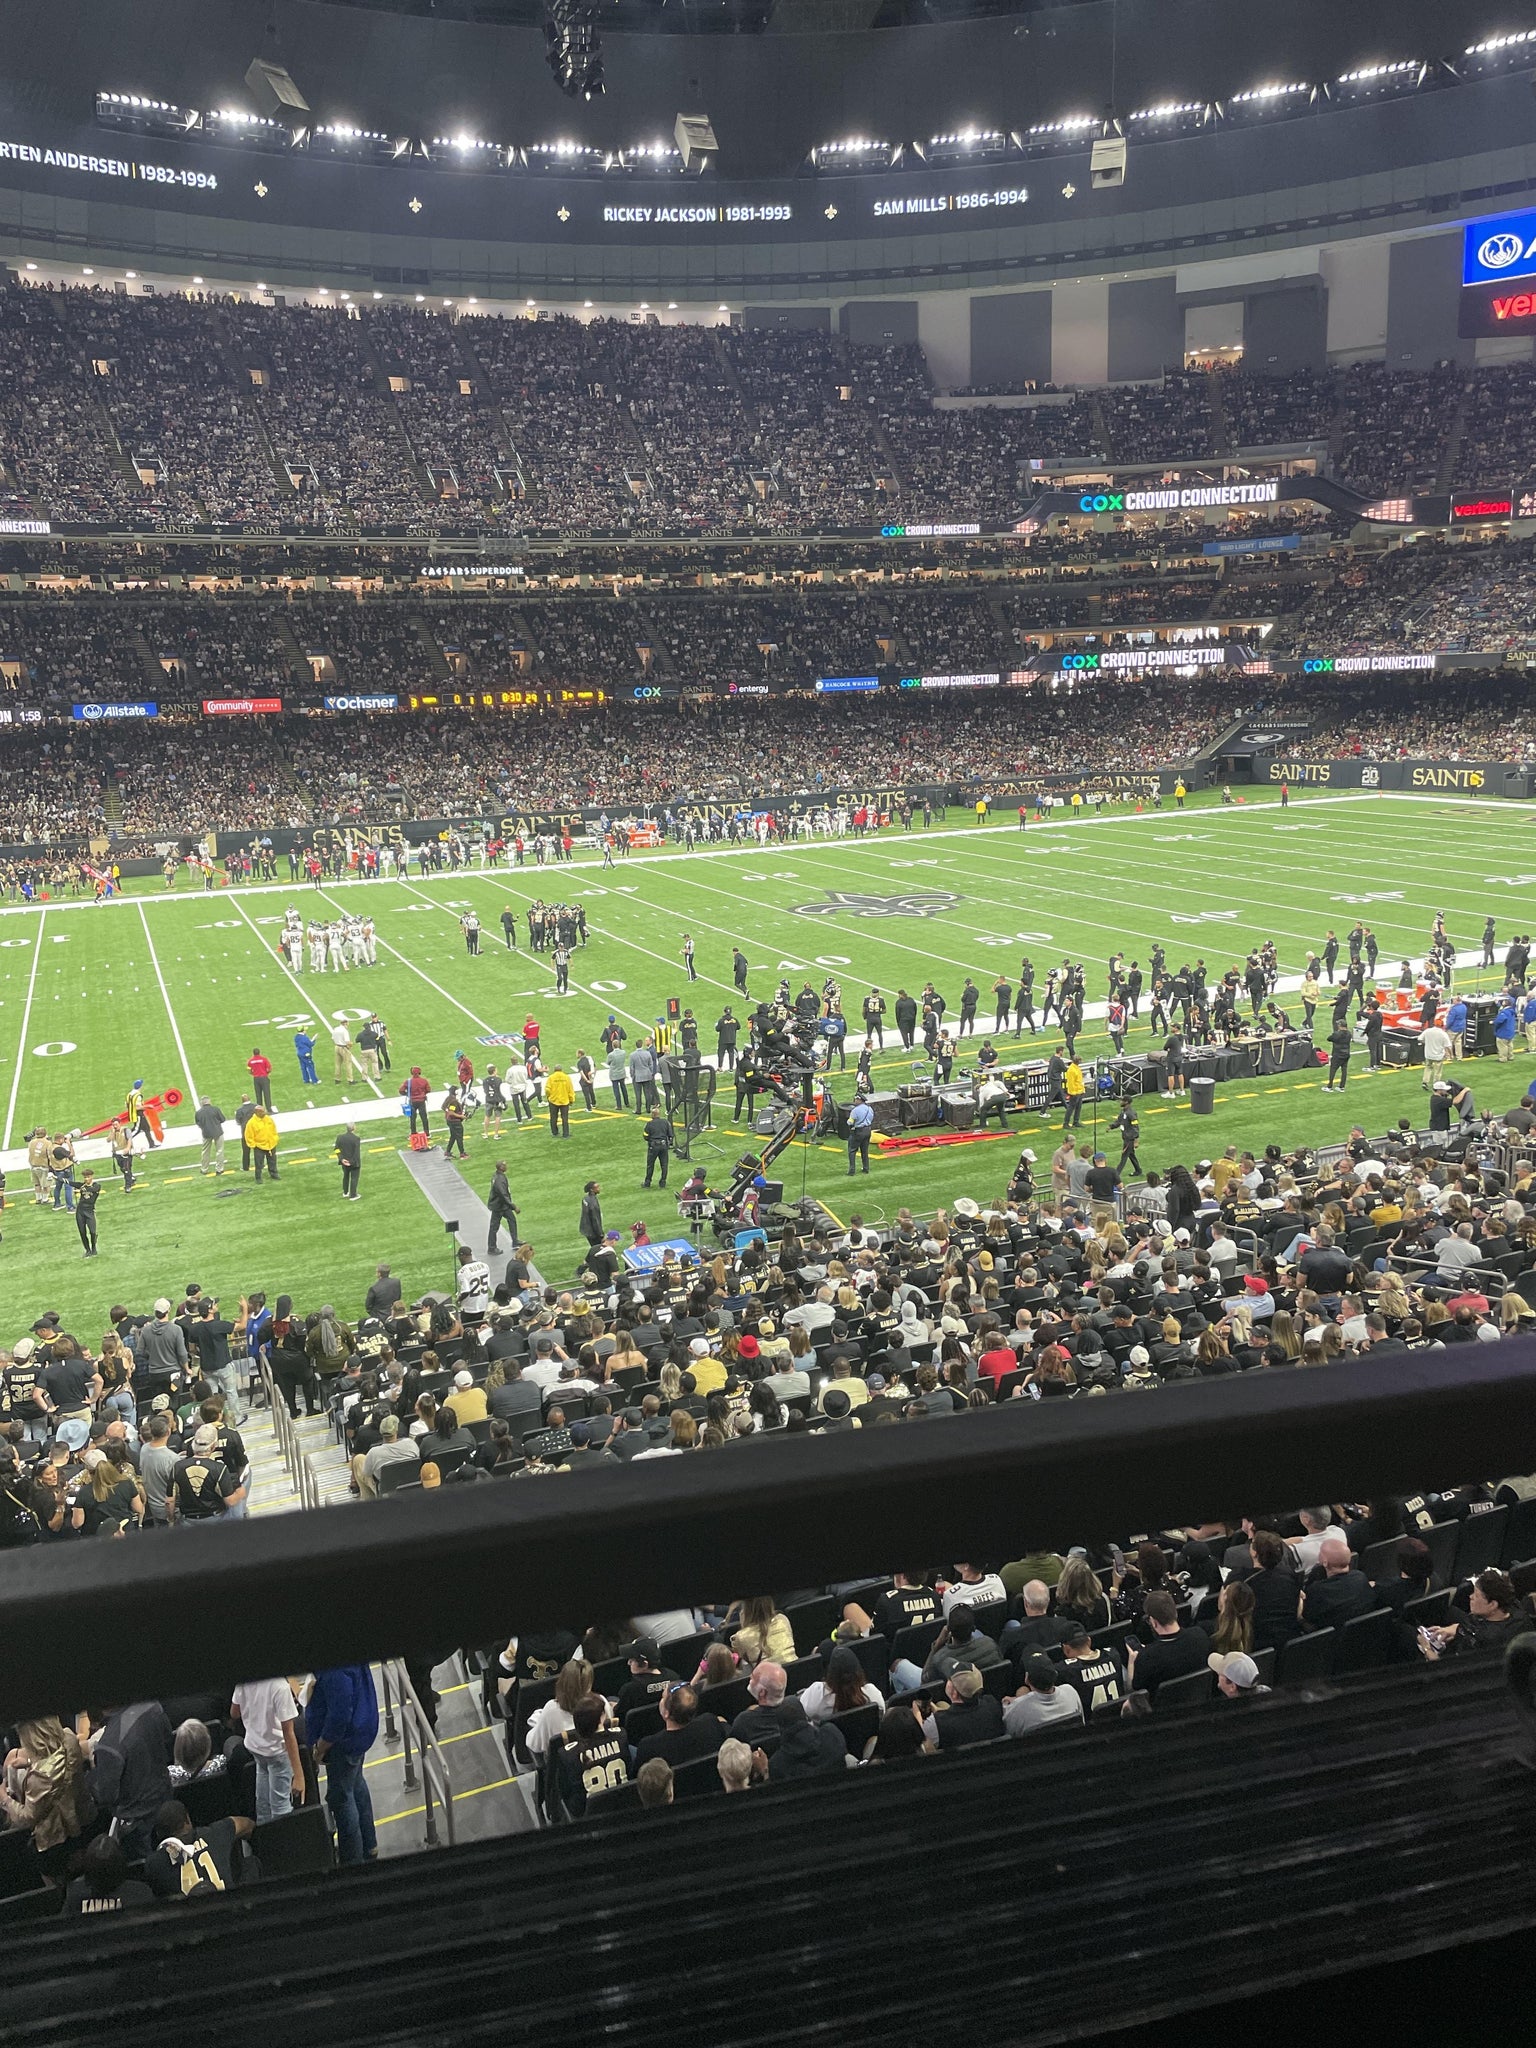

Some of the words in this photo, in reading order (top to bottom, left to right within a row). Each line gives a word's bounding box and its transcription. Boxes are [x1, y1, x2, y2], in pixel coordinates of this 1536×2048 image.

[0, 141, 41, 163] RTEN
[44, 149, 129, 177] ANDERSEN
[139, 164, 218, 189] 1982-1994
[874, 201, 904, 216] SAM
[906, 197, 946, 213] MILLS
[956, 188, 1029, 209] 1986-1994
[604, 207, 652, 222] RICKEY
[654, 207, 716, 222] JACKSON
[726, 206, 791, 222] 1981-1993
[1080, 494, 1123, 513] COX
[1126, 490, 1179, 511] CROWD
[1181, 483, 1277, 508] CONNECTION
[1454, 501, 1511, 517] verizon
[155, 525, 194, 534] SAINTS
[243, 526, 280, 536] SAINTS
[326, 528, 361, 537] SAINTS
[406, 528, 441, 538] SAINTS
[559, 530, 591, 538] SAINTS
[631, 529, 663, 538] SAINTS
[701, 529, 733, 537] SAINTS
[771, 528, 802, 537] SAINTS
[881, 526, 905, 537] COX
[906, 525, 932, 536] CROWD
[933, 524, 980, 535] CONNECTION
[421, 567, 470, 576] CAESARS
[470, 567, 524, 575] SUPERDOME
[1062, 654, 1098, 669] COX
[1101, 652, 1146, 668] CROWD
[1148, 648, 1225, 667] CONNECTION
[1303, 659, 1333, 672] COX
[1335, 658, 1369, 671] CROWD
[1371, 655, 1435, 670] CONNECTION
[900, 677, 920, 688] COX
[922, 676, 949, 687] CROWD
[950, 673, 1000, 686] CONNECTION
[634, 687, 661, 698] COX
[739, 684, 768, 694] entergy
[161, 704, 198, 713] SAINTS
[207, 701, 253, 713] Community
[337, 697, 394, 710] Ochsner
[20, 709, 42, 722] 1:58
[1270, 764, 1330, 781] SAINTS
[1412, 768, 1485, 788] SAINTS
[973, 932, 1053, 946] 50
[777, 956, 852, 971] 40
[271, 1009, 373, 1030] 20
[1404, 1135, 1416, 1145] 37
[469, 1263, 485, 1272] BUSH
[470, 1274, 488, 1297] 25
[880, 1318, 898, 1328] KAMARA
[903, 1598, 935, 1612] KAMARA
[1081, 1661, 1116, 1682] KAMARA
[1091, 1680, 1119, 1712] 41
[181, 1851, 225, 1896] 41
[82, 1898, 122, 1913] KAMARA
